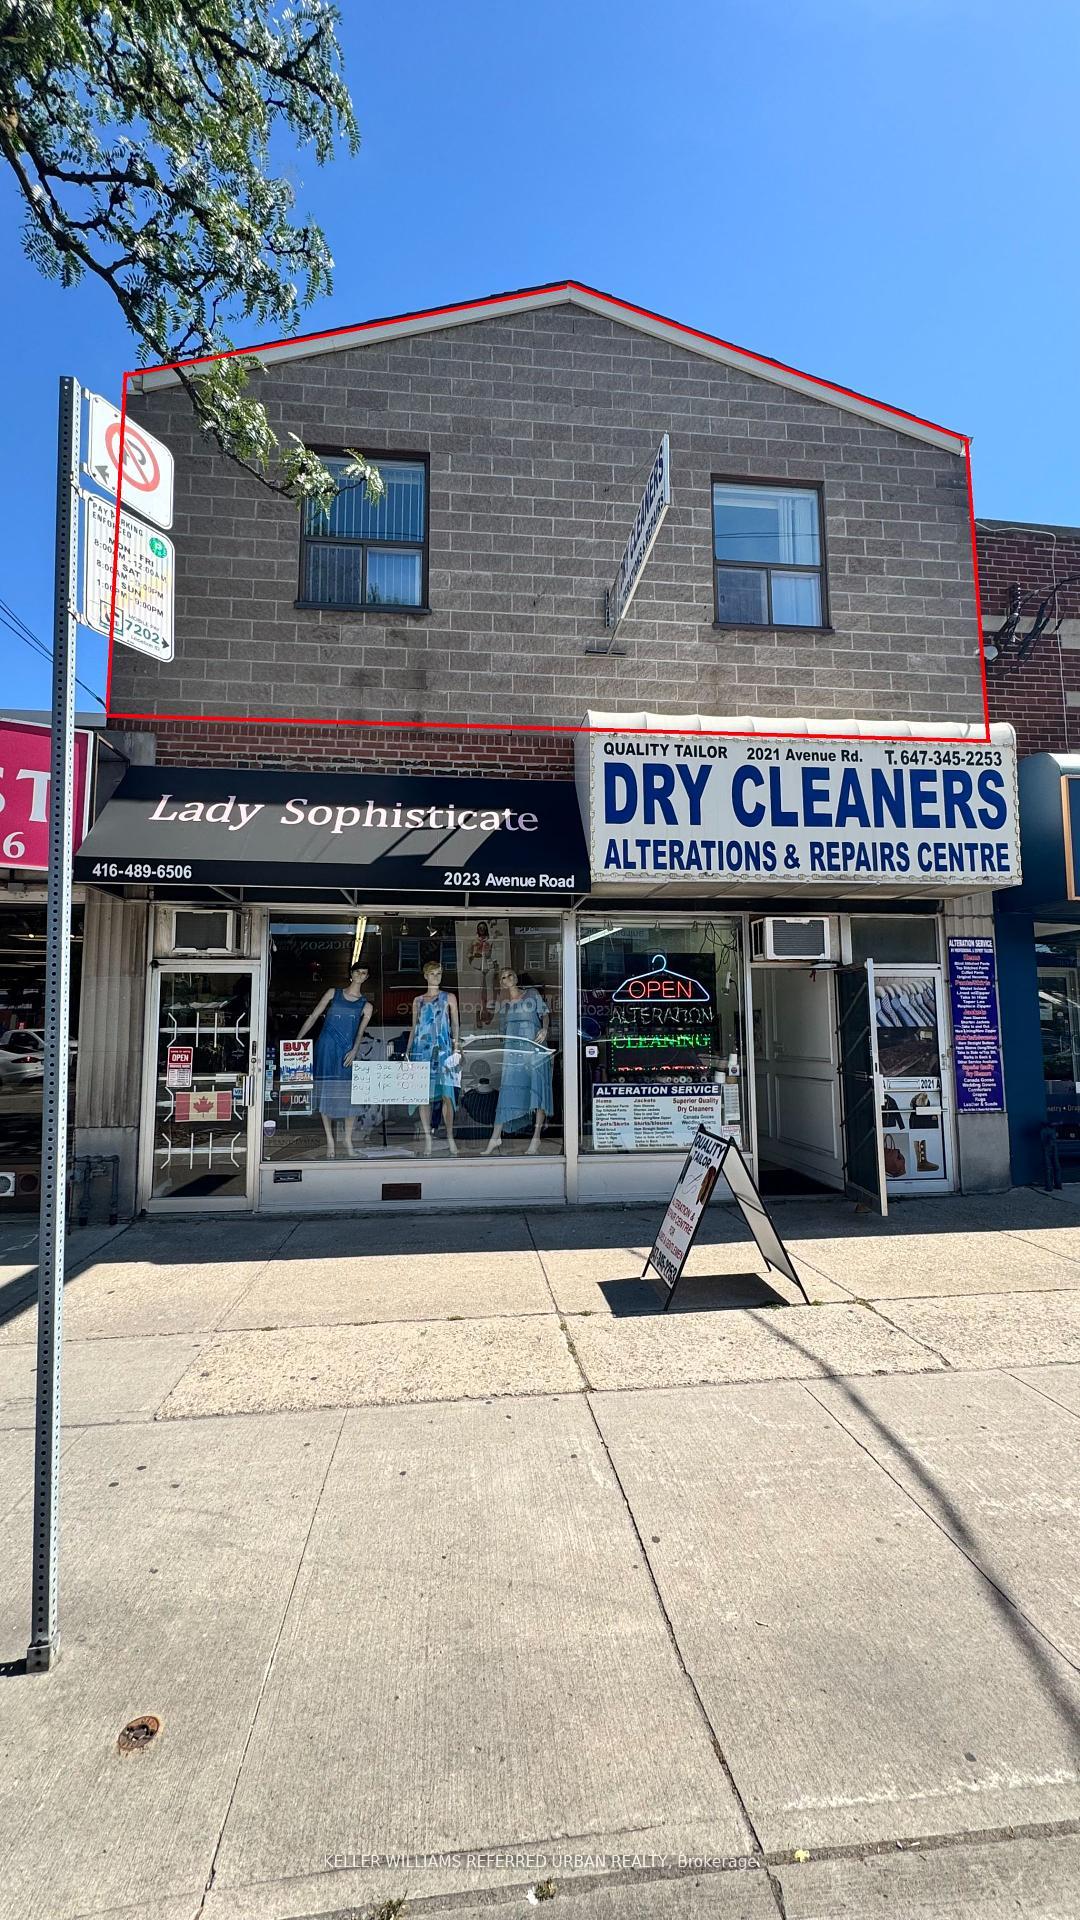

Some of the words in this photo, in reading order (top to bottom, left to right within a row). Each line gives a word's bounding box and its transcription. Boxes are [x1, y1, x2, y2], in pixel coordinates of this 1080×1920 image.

[92, 502, 108, 515] PAY
[110, 509, 143, 537] PRKING
[92, 511, 132, 539] ENFOED
[94, 538, 126, 561] 8:00M
[108, 537, 131, 554] MON
[139, 554, 154, 577] FRI
[122, 563, 140, 578] SAT
[121, 581, 142, 598] SUN
[125, 619, 160, 645] 7202
[603, 742, 670, 757] QUALITY
[674, 743, 728, 759] TAILOR
[747, 747, 780, 761] 2021
[786, 748, 836, 762] Avenue
[841, 749, 863, 763] Rd.
[0, 766, 51, 823] T
[603, 761, 713, 826] DRY
[732, 764, 1008, 830] CLEANERS
[148, 794, 266, 831] Lady
[280, 798, 539, 834] Sophisticate
[2, 832, 26, 859] 6
[604, 838, 777, 872] ALTERATIONS
[783, 843, 801, 870] &
[809, 841, 910, 872] REPAIRS
[917, 842, 1011, 873] CENTRE
[92, 862, 193, 880] 416-489-6506
[444, 871, 480, 886] 2023
[485, 872, 536, 888] Avenue
[539, 873, 575, 889] Road
[948, 939, 975, 948] ALTERATION
[975, 939, 993, 948] SERVICE
[628, 980, 692, 999] OPEN
[609, 1006, 714, 1025] ALTERATION
[283, 1042, 310, 1052] BUY
[612, 1035, 711, 1049] CLEANING
[171, 1053, 189, 1062] OPEN
[596, 1086, 669, 1096] ALTERATION
[671, 1085, 719, 1095] SERVICE
[920, 1079, 934, 1089] 2021
[290, 1095, 310, 1105] LOCAL
[672, 1097, 697, 1105] Superior
[698, 1097, 719, 1105] Quality
[677, 1105, 688, 1113] Dry
[694, 1134, 727, 1159] QUALITY
[693, 1150, 712, 1169] TAILOR
[674, 1213, 694, 1235] CENTRE
